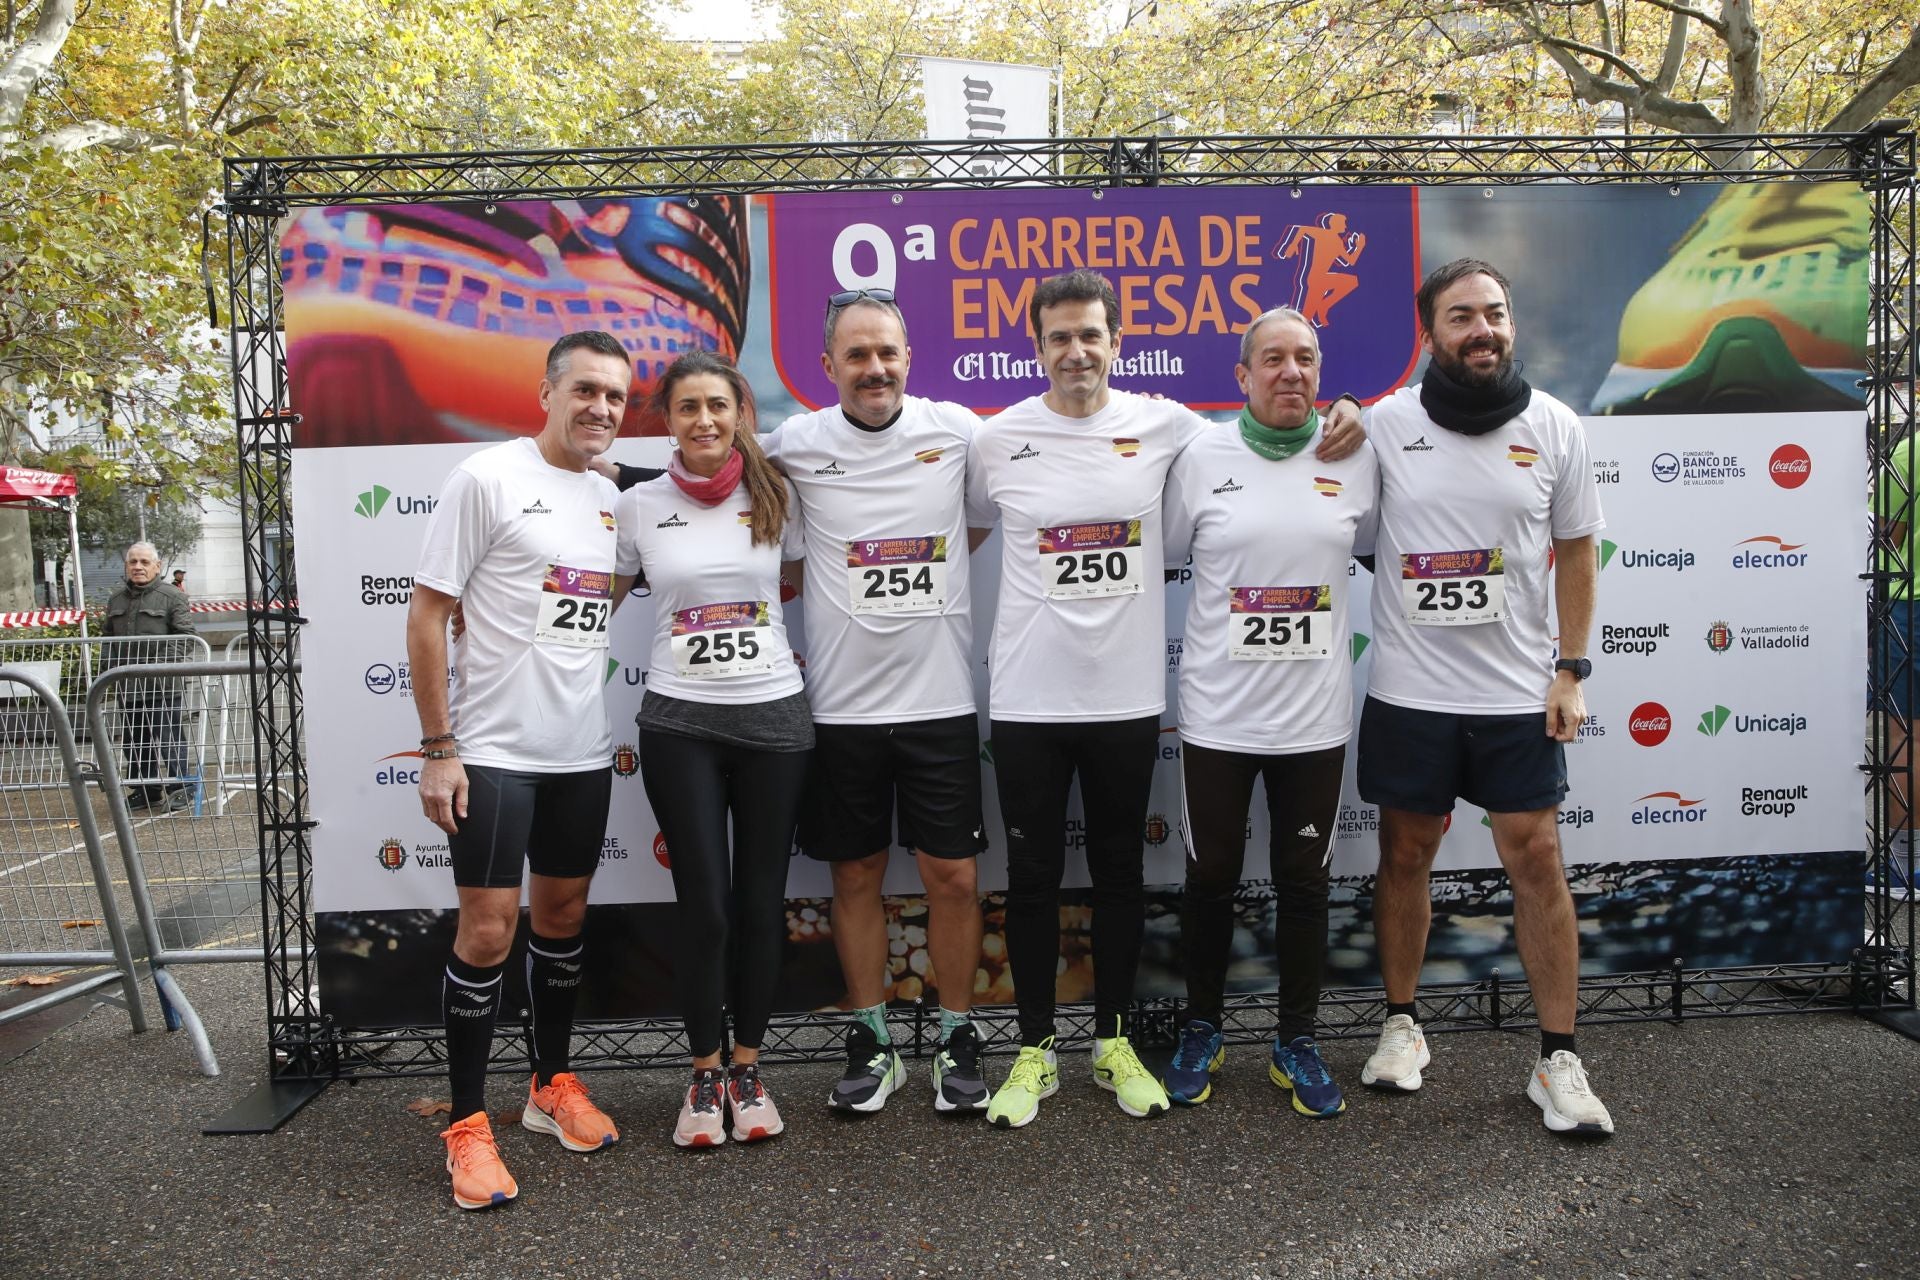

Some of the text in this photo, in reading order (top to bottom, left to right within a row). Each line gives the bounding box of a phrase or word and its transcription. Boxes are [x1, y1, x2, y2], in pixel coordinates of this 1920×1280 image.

[949, 216, 1184, 270] CARRERA
[1200, 215, 1262, 267] DE
[953, 273, 1261, 338] EMESAS
[953, 349, 1185, 381] El Nort astilla
[1011, 451, 1041, 461] MERCURY
[1610, 460, 1620, 468] de
[1683, 456, 1737, 467] BANCO DE
[1595, 470, 1620, 484] olid
[1683, 468, 1746, 479] ALIMENTOS
[1213, 485, 1244, 495] MERCURY
[656, 521, 689, 529] MERCURY
[1058, 528, 1071, 543] 9ª
[1071, 526, 1101, 535] CARRERA
[1072, 532, 1111, 542] EMPRESAS
[866, 542, 879, 557] 9ª
[879, 540, 908, 549] CARRERA
[880, 546, 917, 556] EMPRESAS
[1419, 556, 1430, 569] 9ª
[1431, 554, 1461, 562] CARRERA
[1431, 560, 1471, 570] EMPRESAS
[1622, 548, 1695, 572] Unicaja
[1732, 550, 1808, 569] elecnor
[1055, 551, 1128, 585] 250
[863, 565, 934, 599] 254
[361, 591, 413, 606] Grou
[1249, 590, 1262, 604] 9ª
[1262, 589, 1291, 597] CARRERA
[1262, 596, 1300, 604] EMPRESAS
[1417, 580, 1489, 611] 253
[552, 598, 608, 632] 252
[689, 608, 702, 625] 9ª
[702, 606, 731, 616] CARRERA
[702, 611, 740, 622] EMPRESAS
[1243, 615, 1311, 646] 251
[1602, 623, 1669, 639] Renault
[1741, 624, 1809, 635] Ayuntamiento de
[686, 630, 760, 665] 255
[1601, 639, 1657, 656] Group
[1741, 635, 1809, 650] Valladolid
[1577, 727, 1606, 737] NTOS
[1735, 713, 1807, 736] Unicaja
[376, 766, 420, 785] elec
[1741, 785, 1808, 802] Renault
[1361, 810, 1375, 820] DE
[1556, 806, 1594, 828] caja
[1631, 806, 1707, 824] elecnor
[1741, 801, 1795, 818] Group
[415, 854, 453, 868] Valla
[450, 1005, 493, 1018] SPORTLAST
